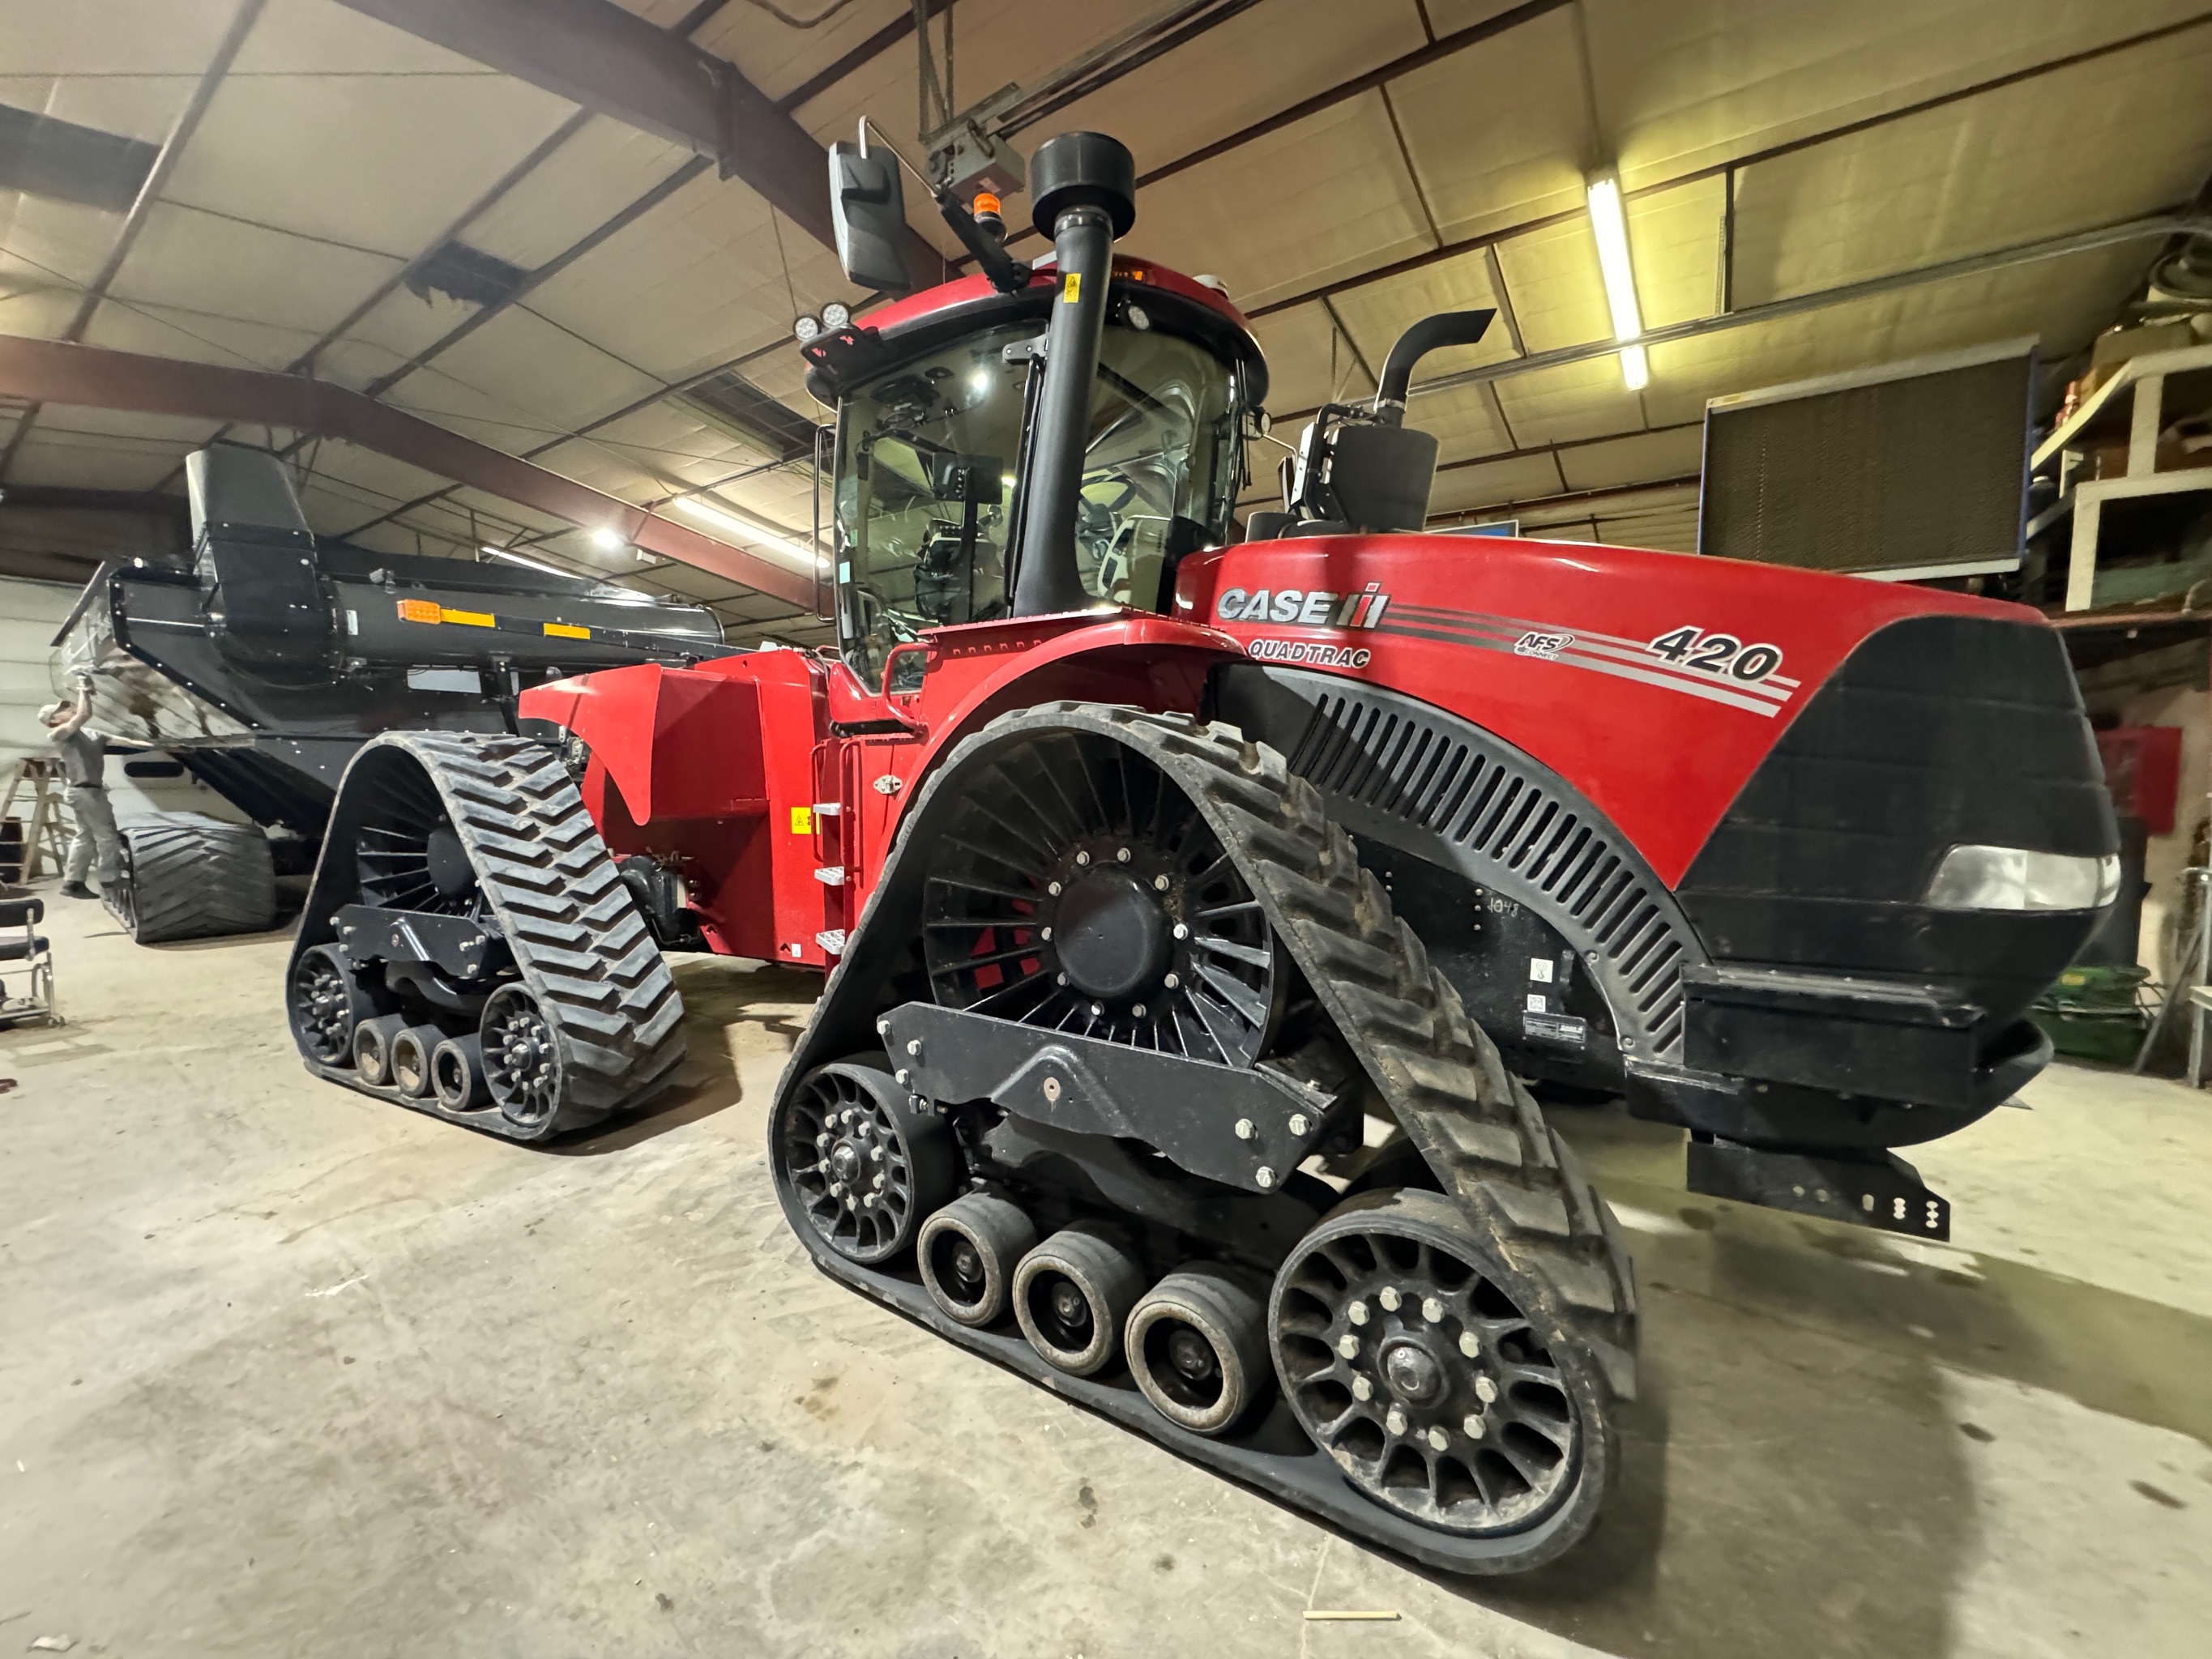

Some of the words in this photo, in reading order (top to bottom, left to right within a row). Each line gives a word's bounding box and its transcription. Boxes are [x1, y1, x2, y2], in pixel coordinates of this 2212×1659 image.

[1218, 588, 1339, 625] CASE
[1249, 639, 1371, 668] QUADTRAC
[1517, 633, 1561, 651] AFS
[1524, 648, 1558, 660] CONNECT
[1647, 625, 1783, 684] 420
